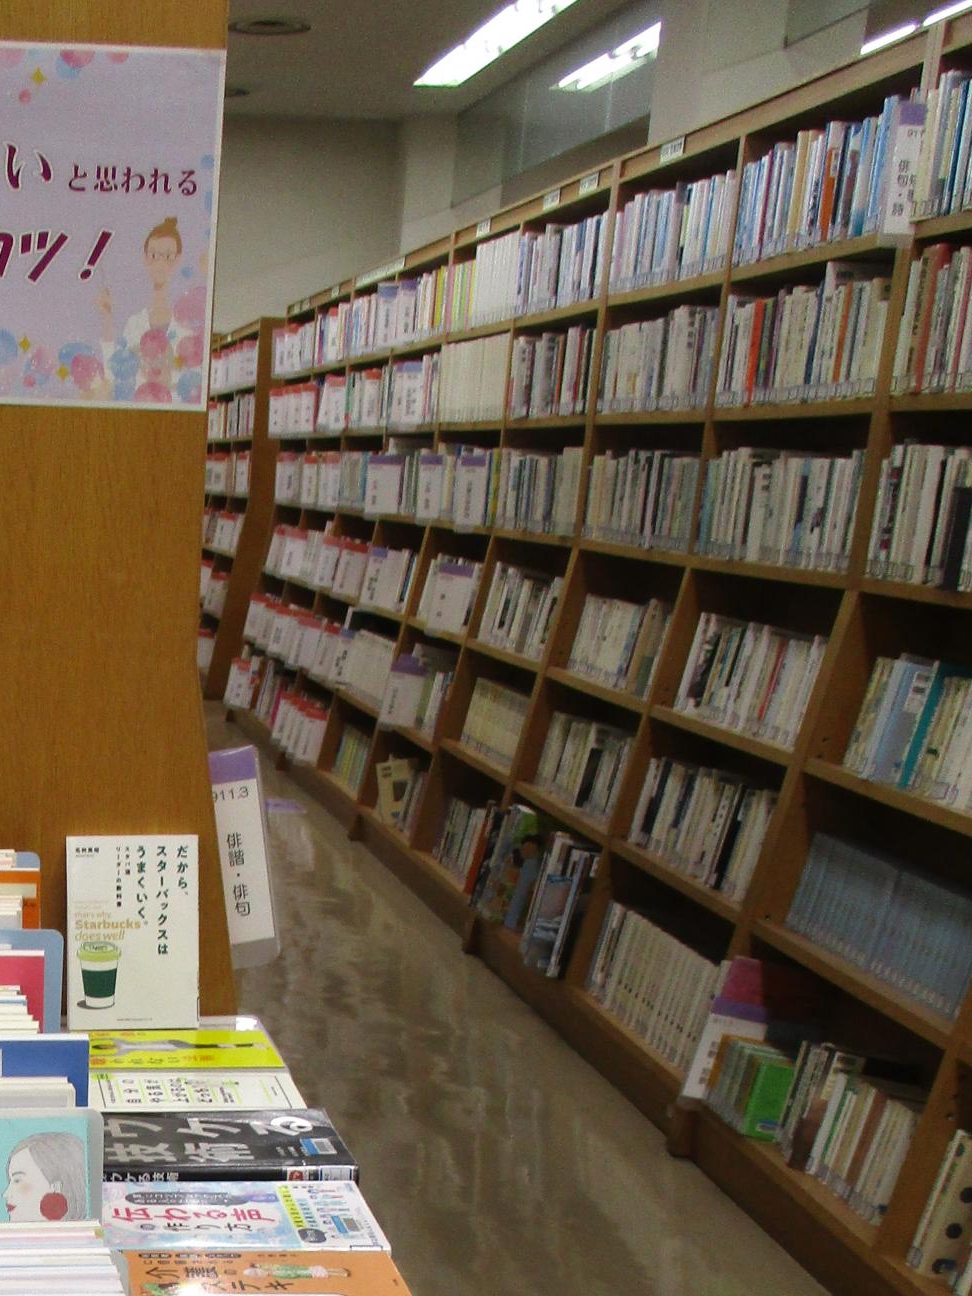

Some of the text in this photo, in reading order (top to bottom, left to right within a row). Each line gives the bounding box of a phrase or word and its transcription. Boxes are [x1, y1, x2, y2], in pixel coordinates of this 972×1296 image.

[177, 845, 190, 896] だから、
[227, 832, 251, 917] 俳諧・俳句
[136, 845, 148, 926] うまくいく。
[156, 845, 169, 956] スターバックスは
[75, 919, 141, 929] Starbucks
[75, 930, 126, 941] does well
[106, 1143, 255, 1162] 技術
[112, 1207, 276, 1222] 伝わる声
[139, 1223, 253, 1232] の作り方
